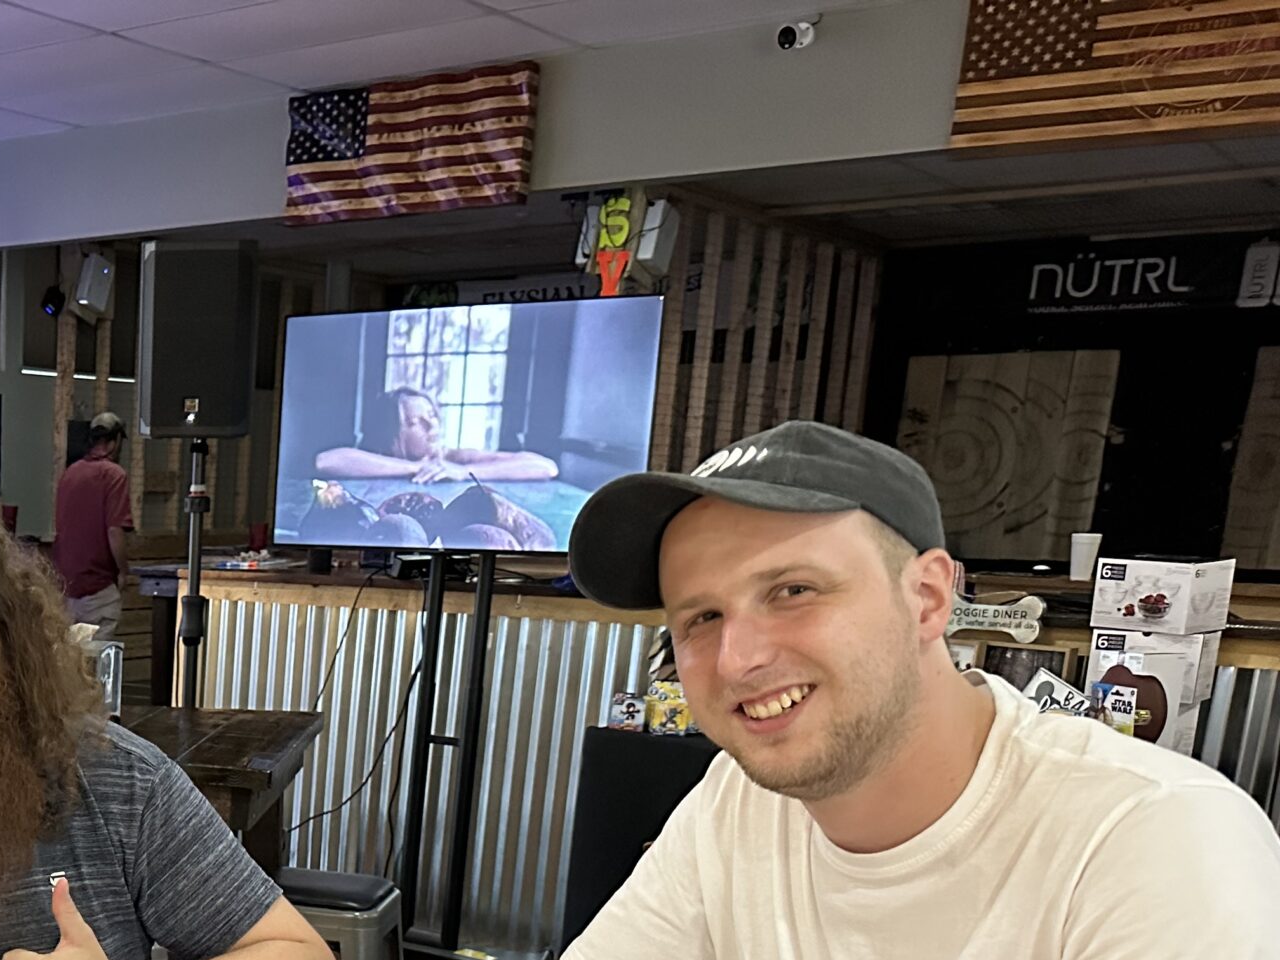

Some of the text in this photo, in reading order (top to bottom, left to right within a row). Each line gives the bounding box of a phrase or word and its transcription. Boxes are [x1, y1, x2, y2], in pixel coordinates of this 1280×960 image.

[1102, 565, 1112, 577] 6
[952, 607, 1028, 619] OGGIE DINER
[965, 619, 985, 627] water
[988, 620, 1012, 629] served
[1014, 621, 1023, 629] all
[1024, 622, 1037, 632] day
[1097, 636, 1108, 648] 6
[1111, 699, 1133, 707] STAR
[1111, 705, 1133, 715] WARS
